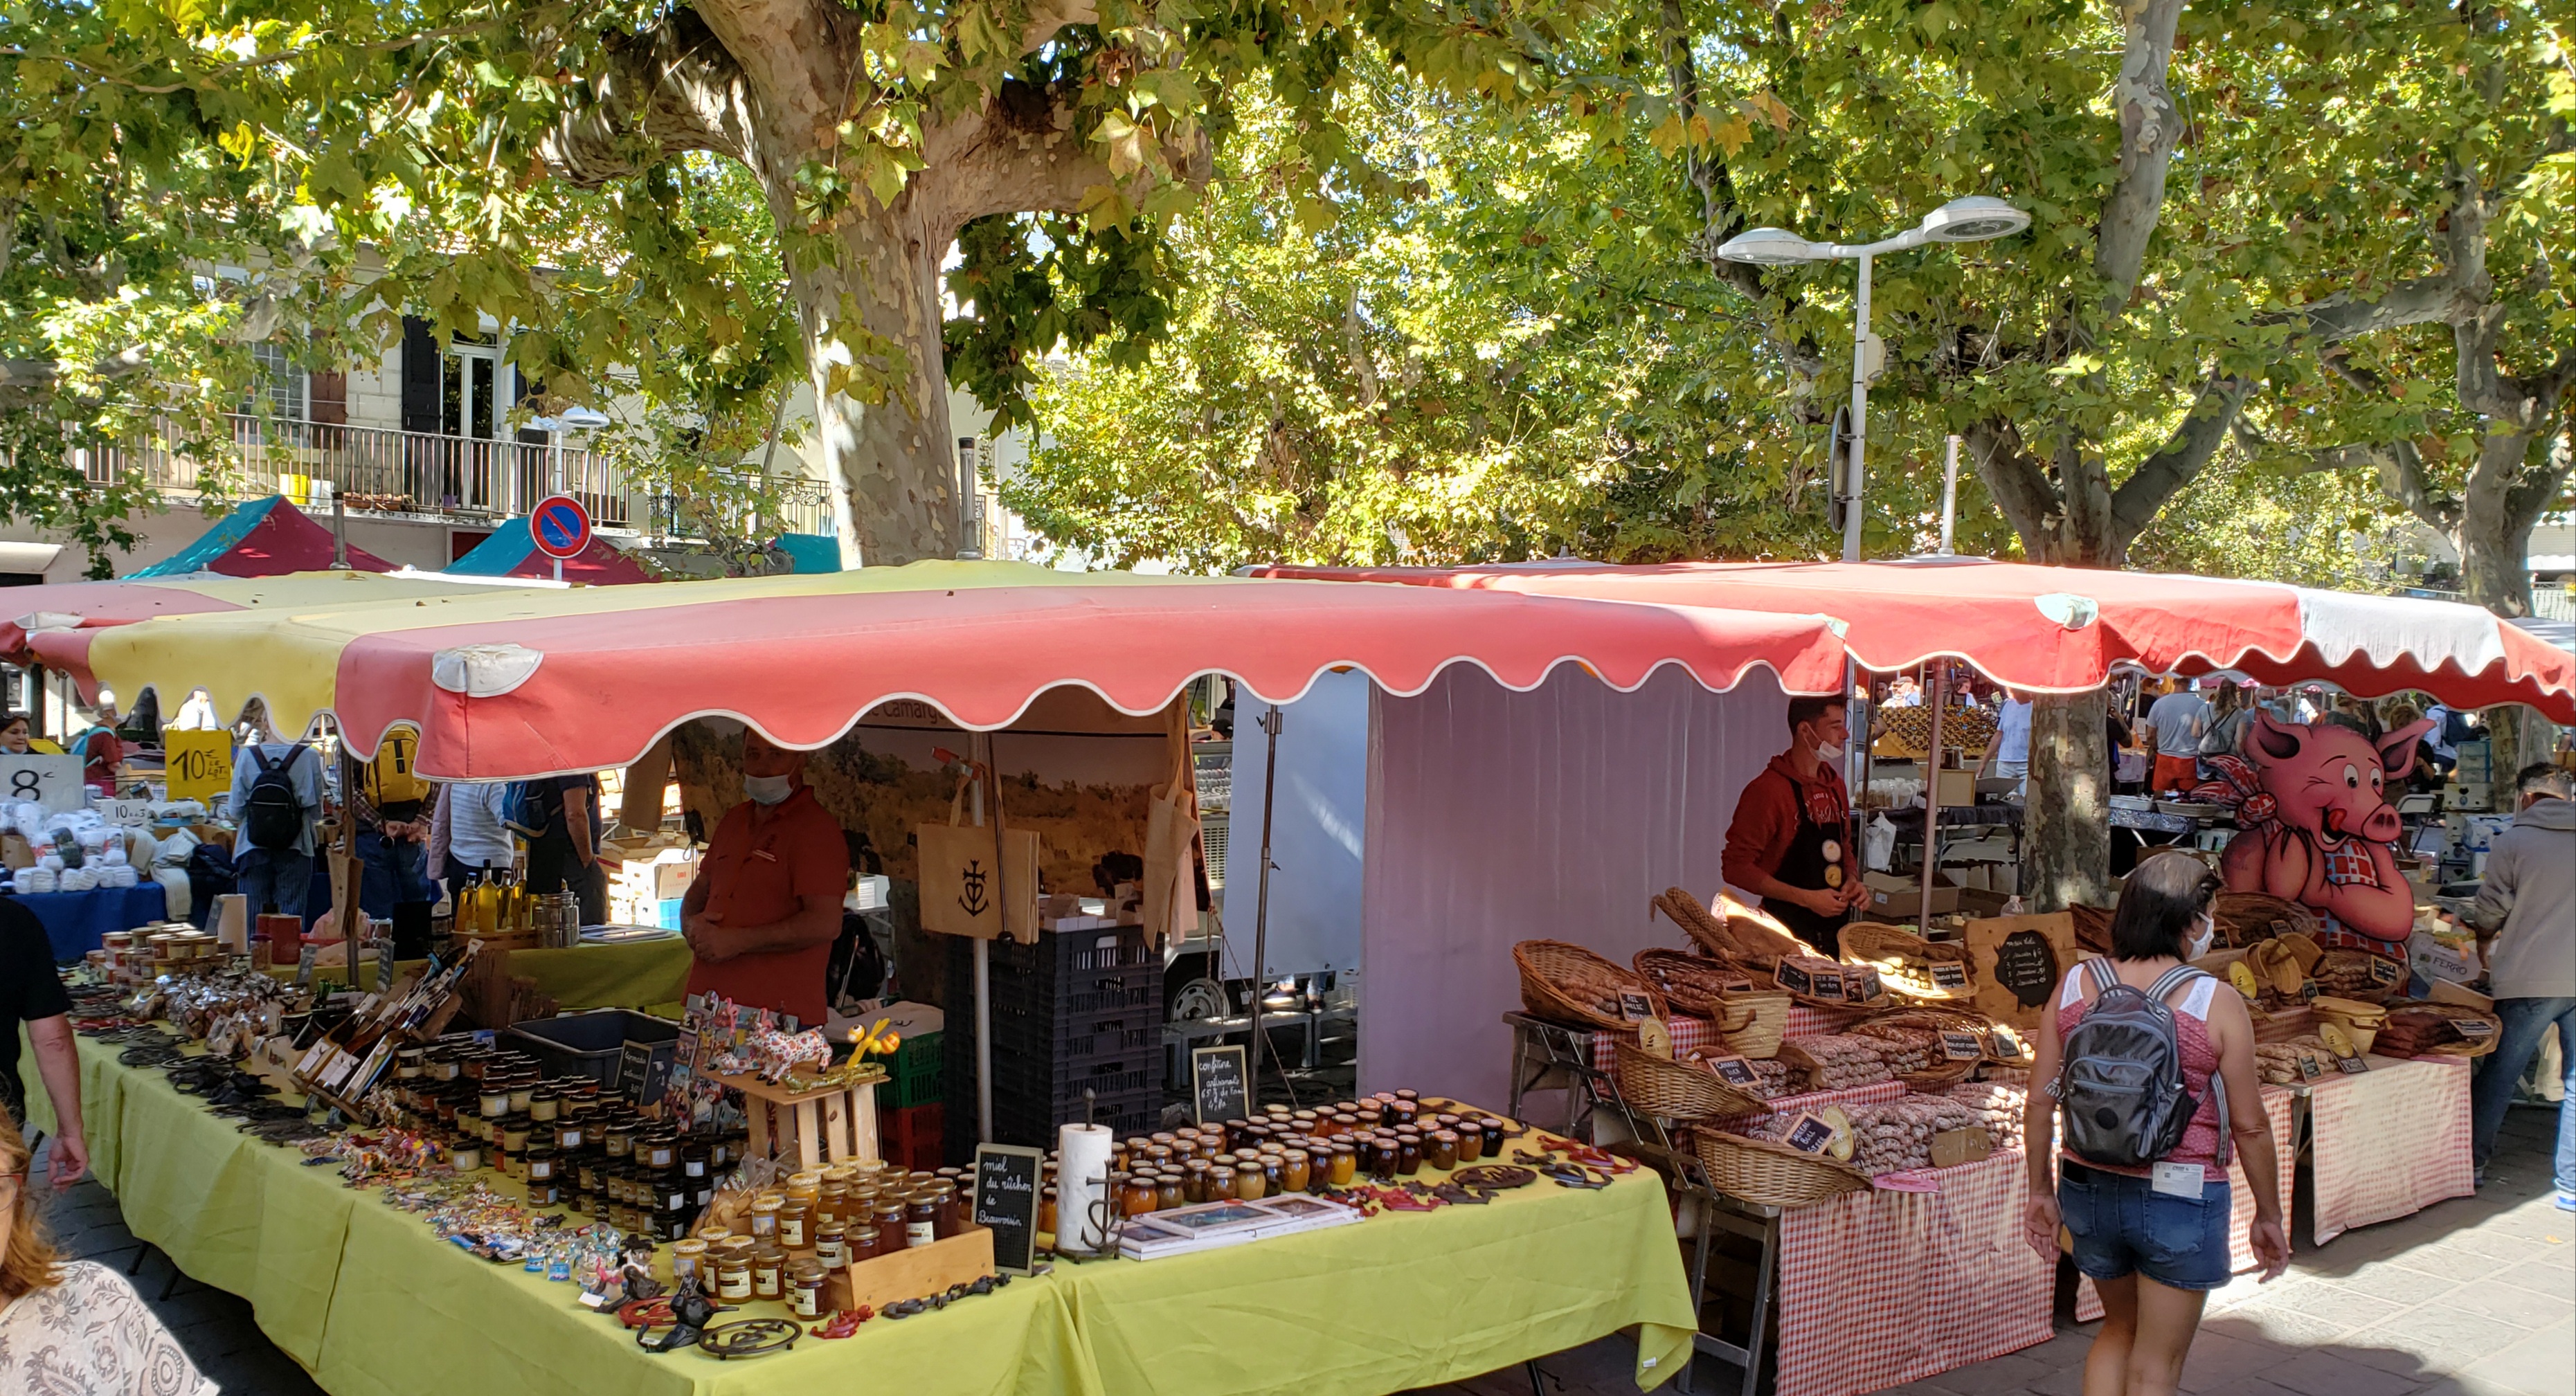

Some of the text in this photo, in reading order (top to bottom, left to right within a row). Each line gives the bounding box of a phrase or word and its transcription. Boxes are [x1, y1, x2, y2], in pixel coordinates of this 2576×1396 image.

[2433, 957, 2467, 975] FERRO
[1800, 1130, 1816, 1144] BULL
[983, 1156, 1007, 1172] miel
[987, 1177, 998, 1189] du
[986, 1194, 996, 1206] de
